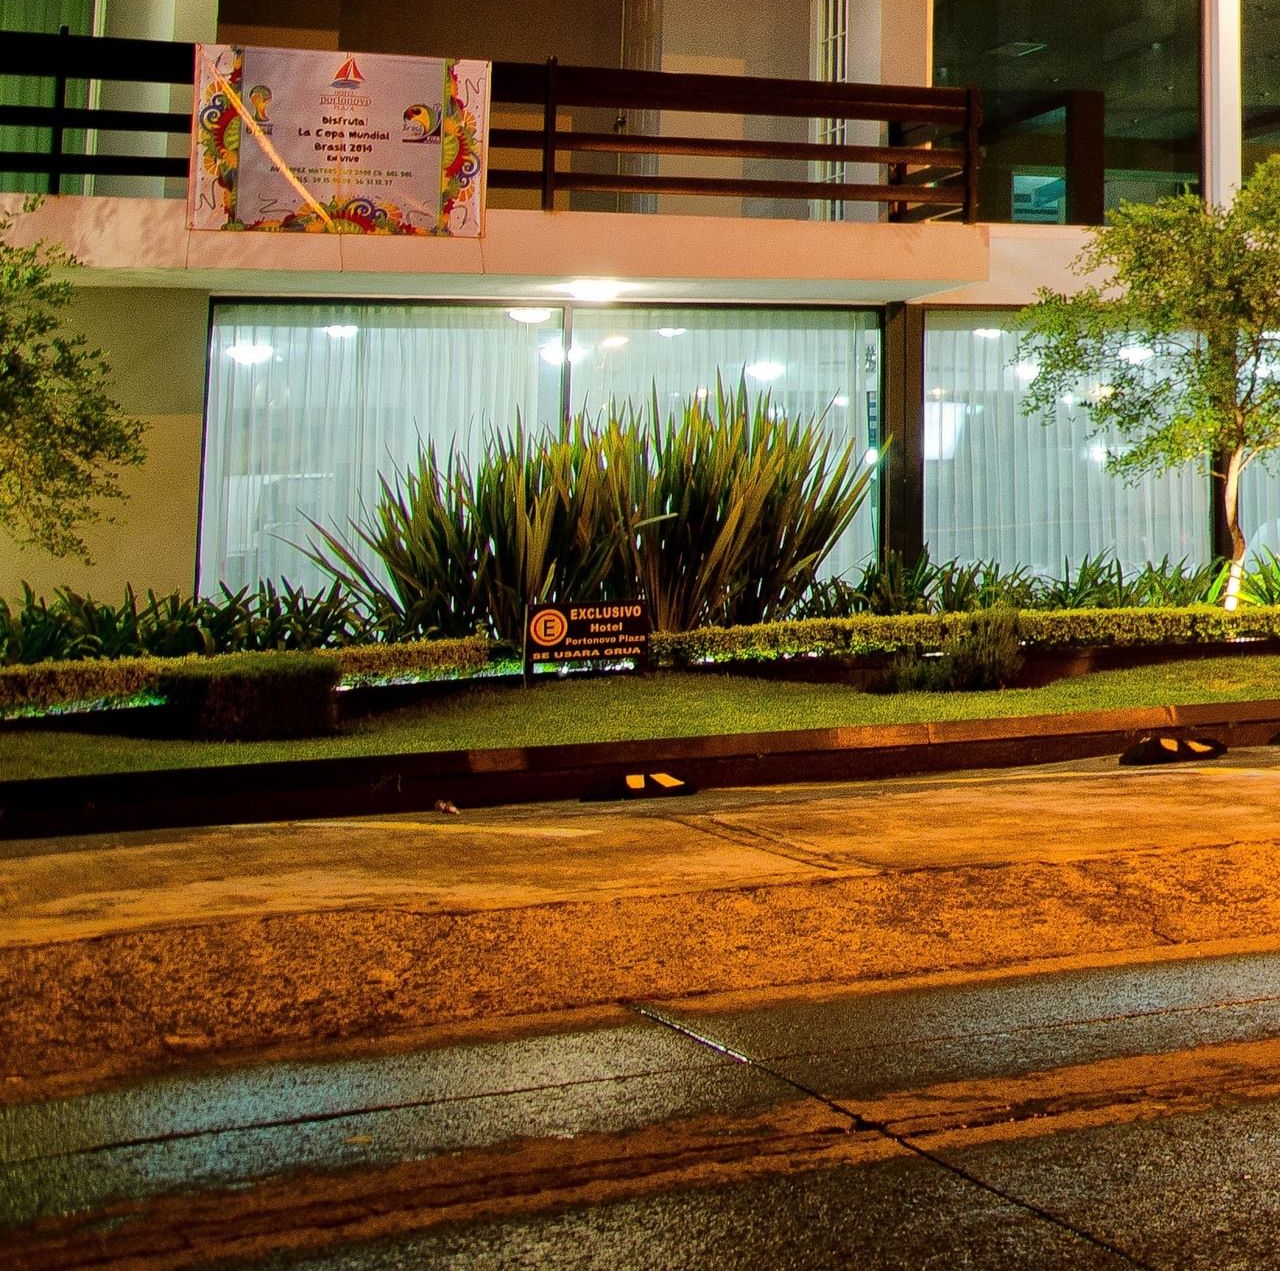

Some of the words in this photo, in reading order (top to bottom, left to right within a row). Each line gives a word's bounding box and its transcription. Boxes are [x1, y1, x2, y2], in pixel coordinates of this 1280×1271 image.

[298, 128, 311, 137] La
[349, 131, 390, 141] Mundial
[314, 142, 346, 153] Brasil
[349, 144, 373, 153] 2014
[570, 605, 642, 620] EXCLUSIVO
[543, 619, 556, 638] E
[590, 622, 623, 633] Hotel
[565, 636, 617, 646] Portonovo
[618, 634, 646, 643] Plaza
[532, 652, 550, 660] SE
[554, 649, 600, 659] USARA
[604, 647, 641, 656] GRUA
